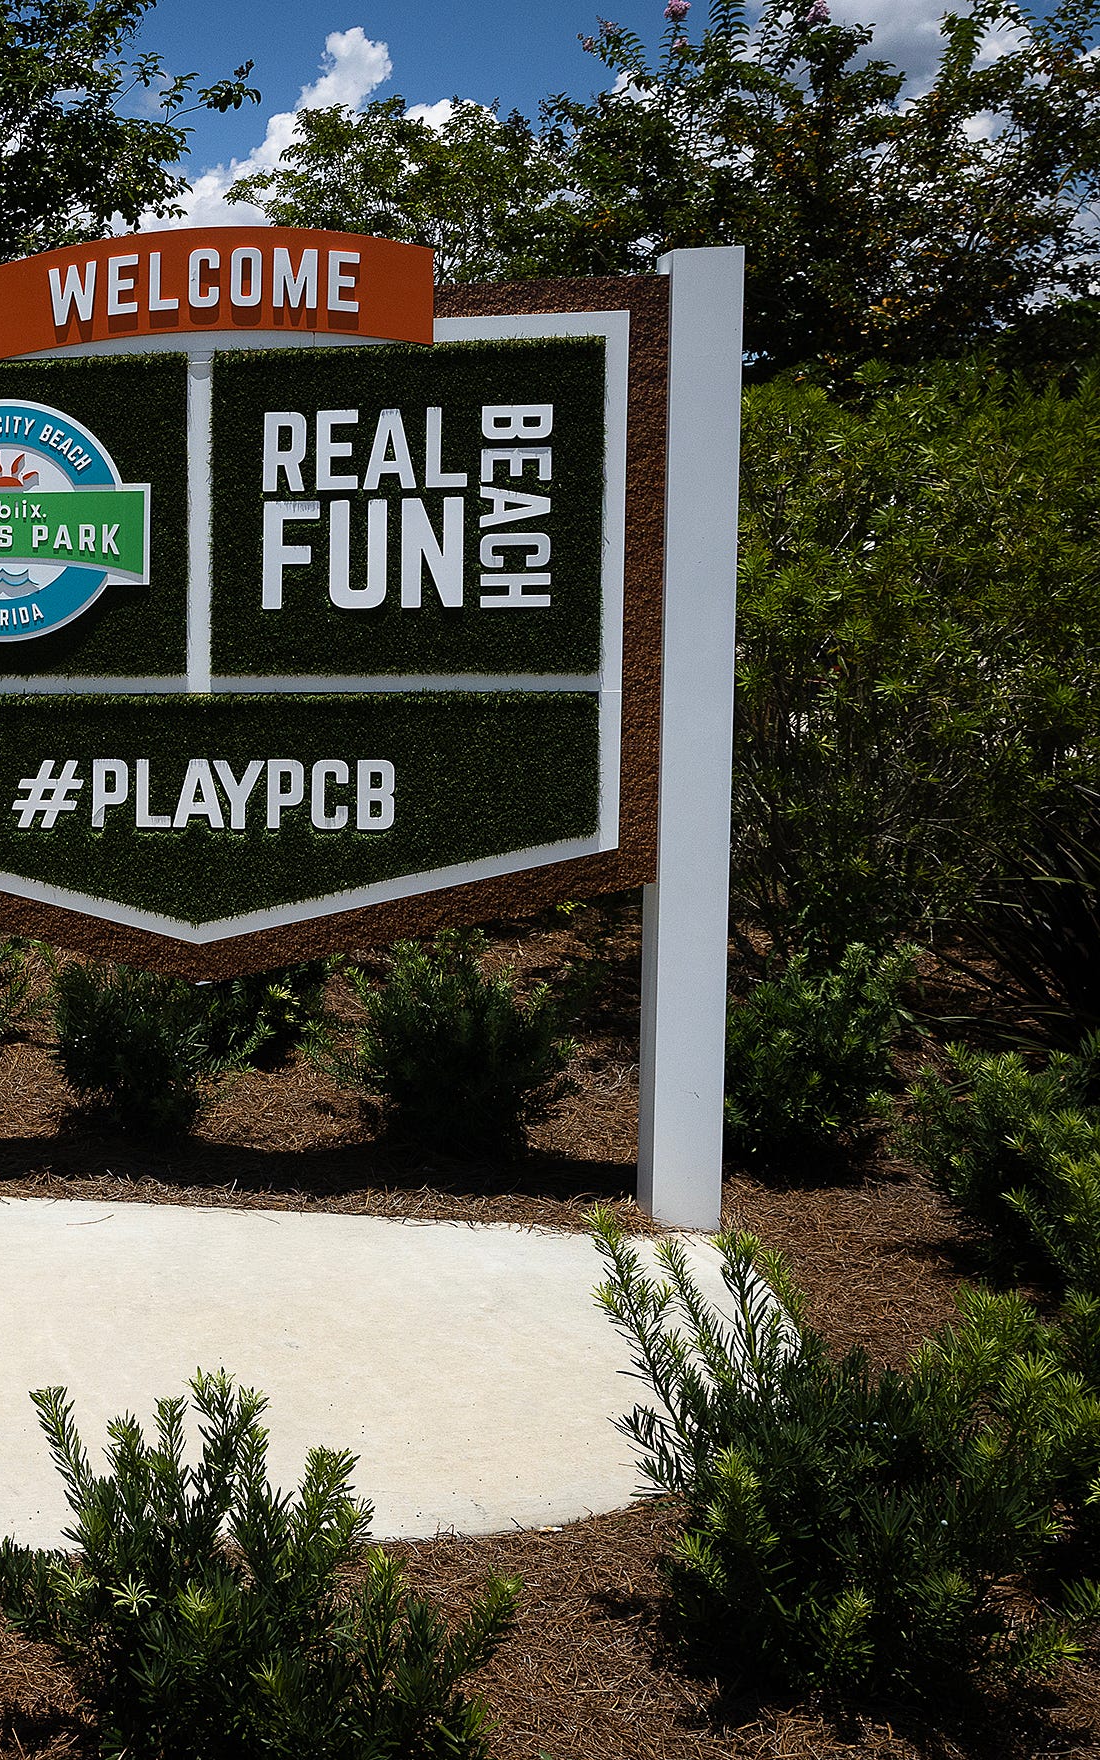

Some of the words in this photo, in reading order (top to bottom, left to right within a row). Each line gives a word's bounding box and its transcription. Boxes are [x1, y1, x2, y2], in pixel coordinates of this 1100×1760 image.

[47, 247, 361, 327] WELCOME
[39, 423, 92, 471] BEACH
[262, 406, 467, 492] REAL
[32, 524, 121, 555] PARK
[479, 404, 553, 608] BEACH
[262, 496, 465, 609] FUN
[11, 759, 395, 830] #PLAYPCB
